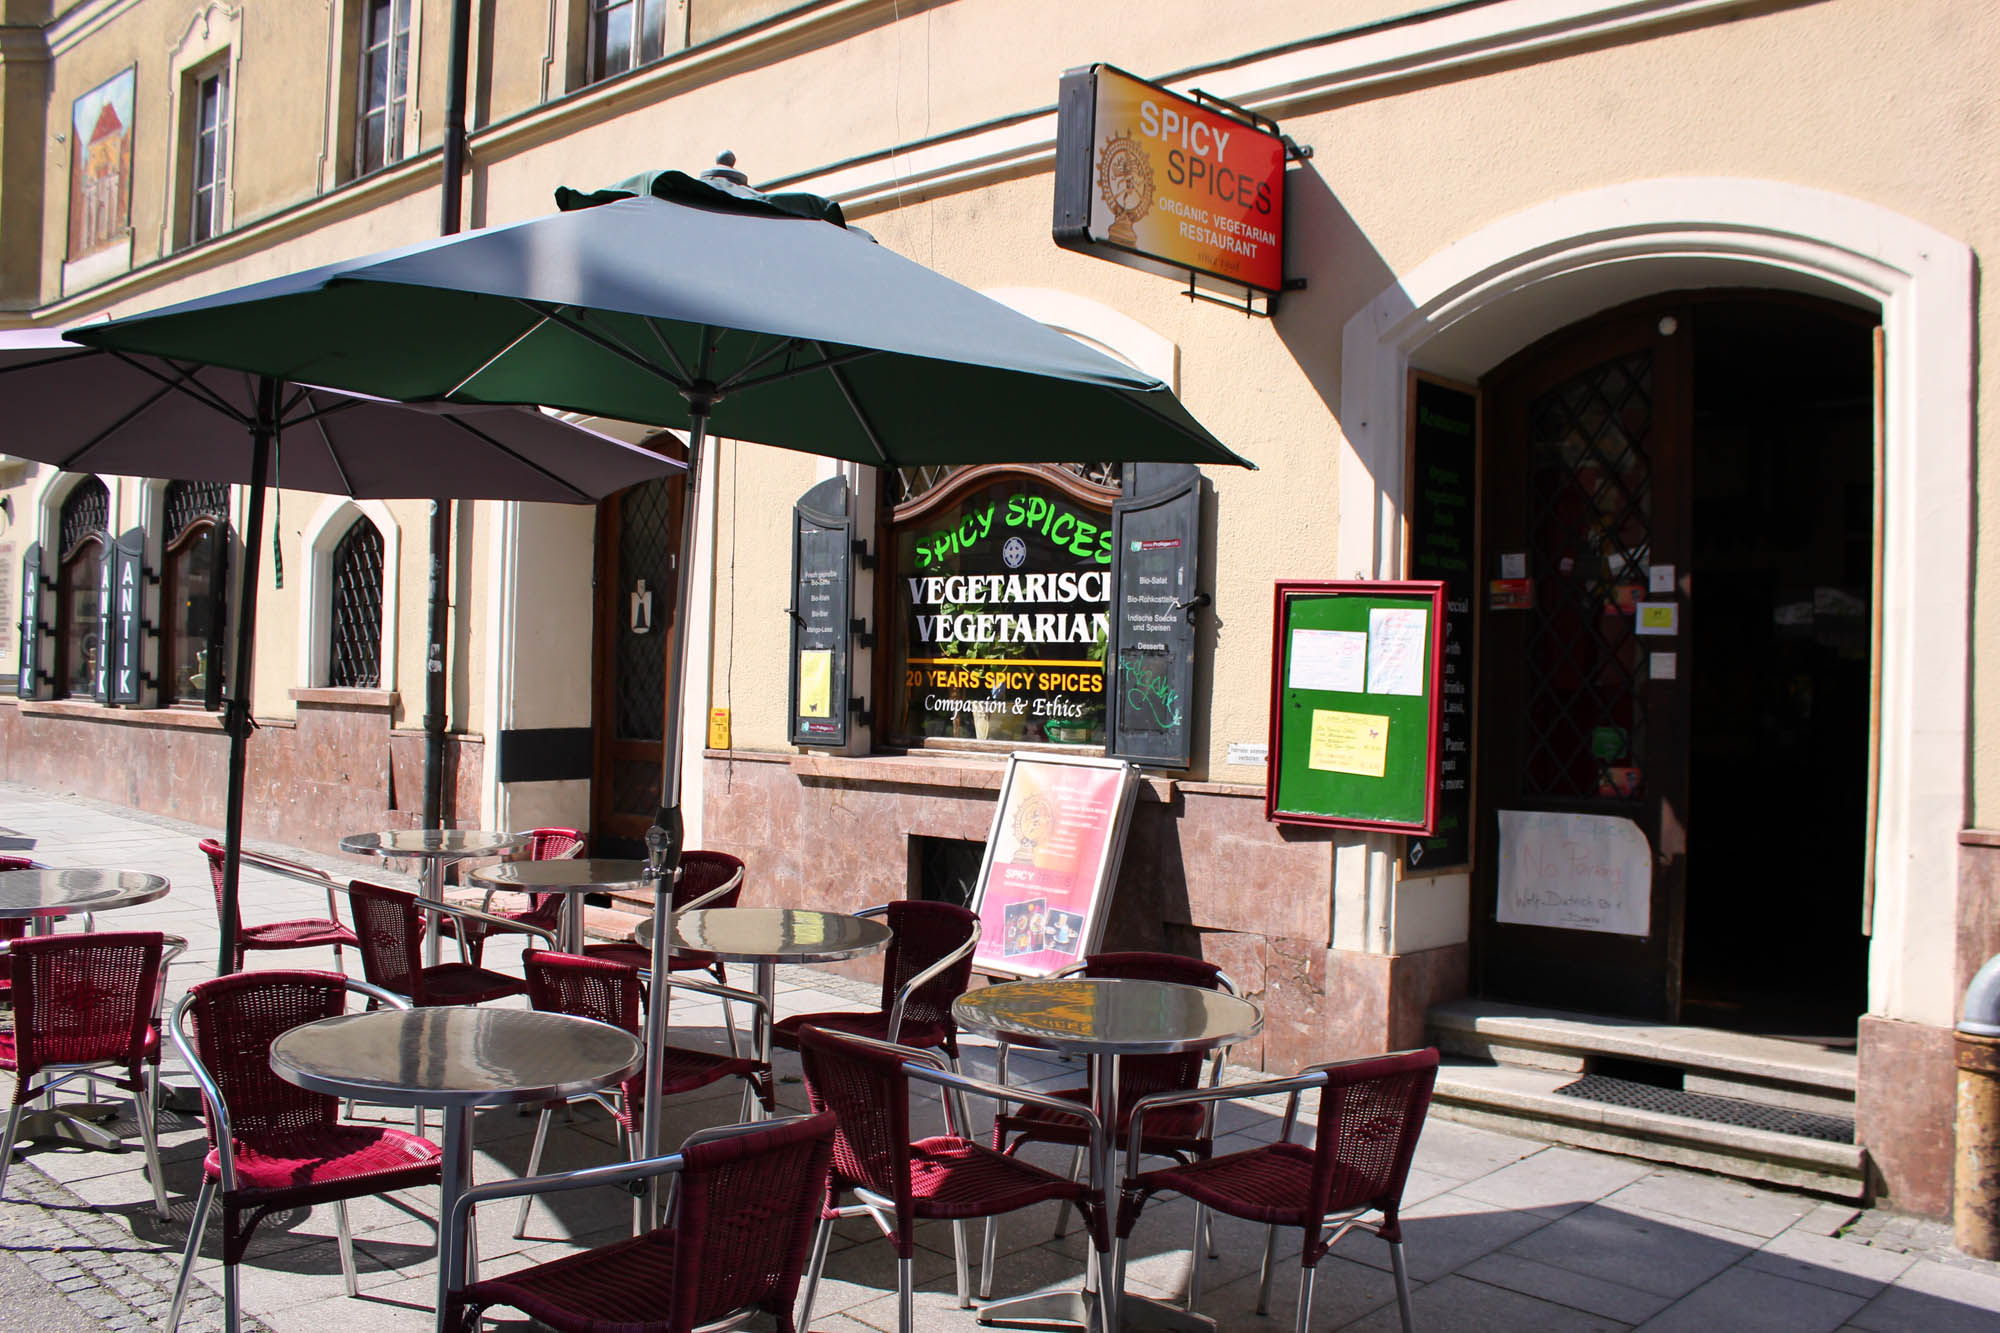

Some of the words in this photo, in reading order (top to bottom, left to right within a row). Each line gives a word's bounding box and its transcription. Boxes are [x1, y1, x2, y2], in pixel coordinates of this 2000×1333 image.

[1139, 100, 1230, 163] SPICY
[1167, 149, 1272, 216] SPICES
[1159, 196, 1209, 225] ORGANIC
[1213, 214, 1276, 247] VEGETARIAN
[1179, 222, 1258, 260] RESTAURANT
[914, 500, 996, 568] SPICY
[1139, 576, 1168, 585] Bio-Salat
[97, 565, 109, 693] ANTIK
[120, 561, 133, 694] ANTIK
[1127, 614, 1153, 623] Indische
[1132, 624, 1144, 632] und
[1146, 624, 1171, 633] Speisen
[1137, 642, 1165, 651] Desserts
[906, 670, 922, 686] 20
[927, 671, 980, 689] YEARS
[984, 671, 1034, 691] SPICY
[1038, 672, 1103, 693] SPICES
[924, 694, 1006, 720] Compassion
[1012, 697, 1028, 715] &
[1032, 694, 1083, 718] Ethics
[1005, 869, 1034, 881] SPICY
